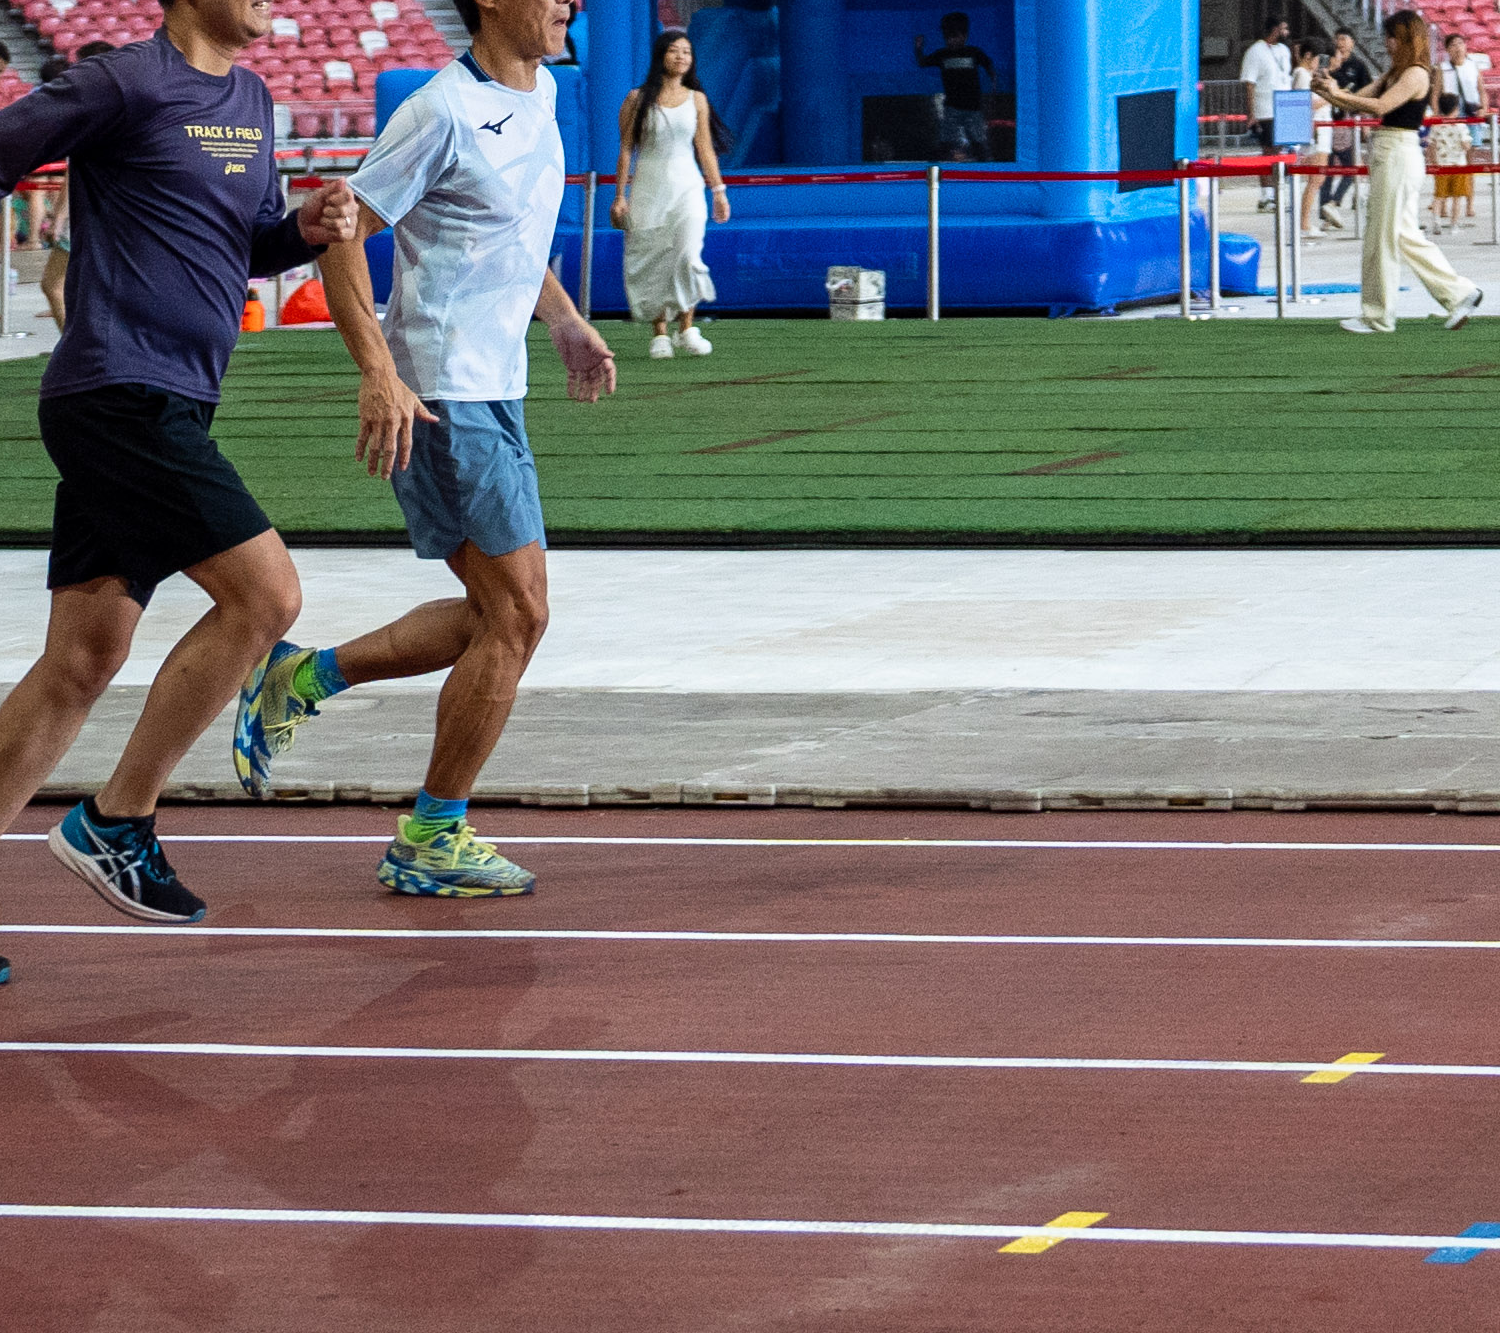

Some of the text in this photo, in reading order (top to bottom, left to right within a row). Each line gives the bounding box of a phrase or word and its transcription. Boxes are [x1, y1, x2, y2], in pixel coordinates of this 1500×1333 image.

[184, 125, 263, 141] TRACK & FIELD
